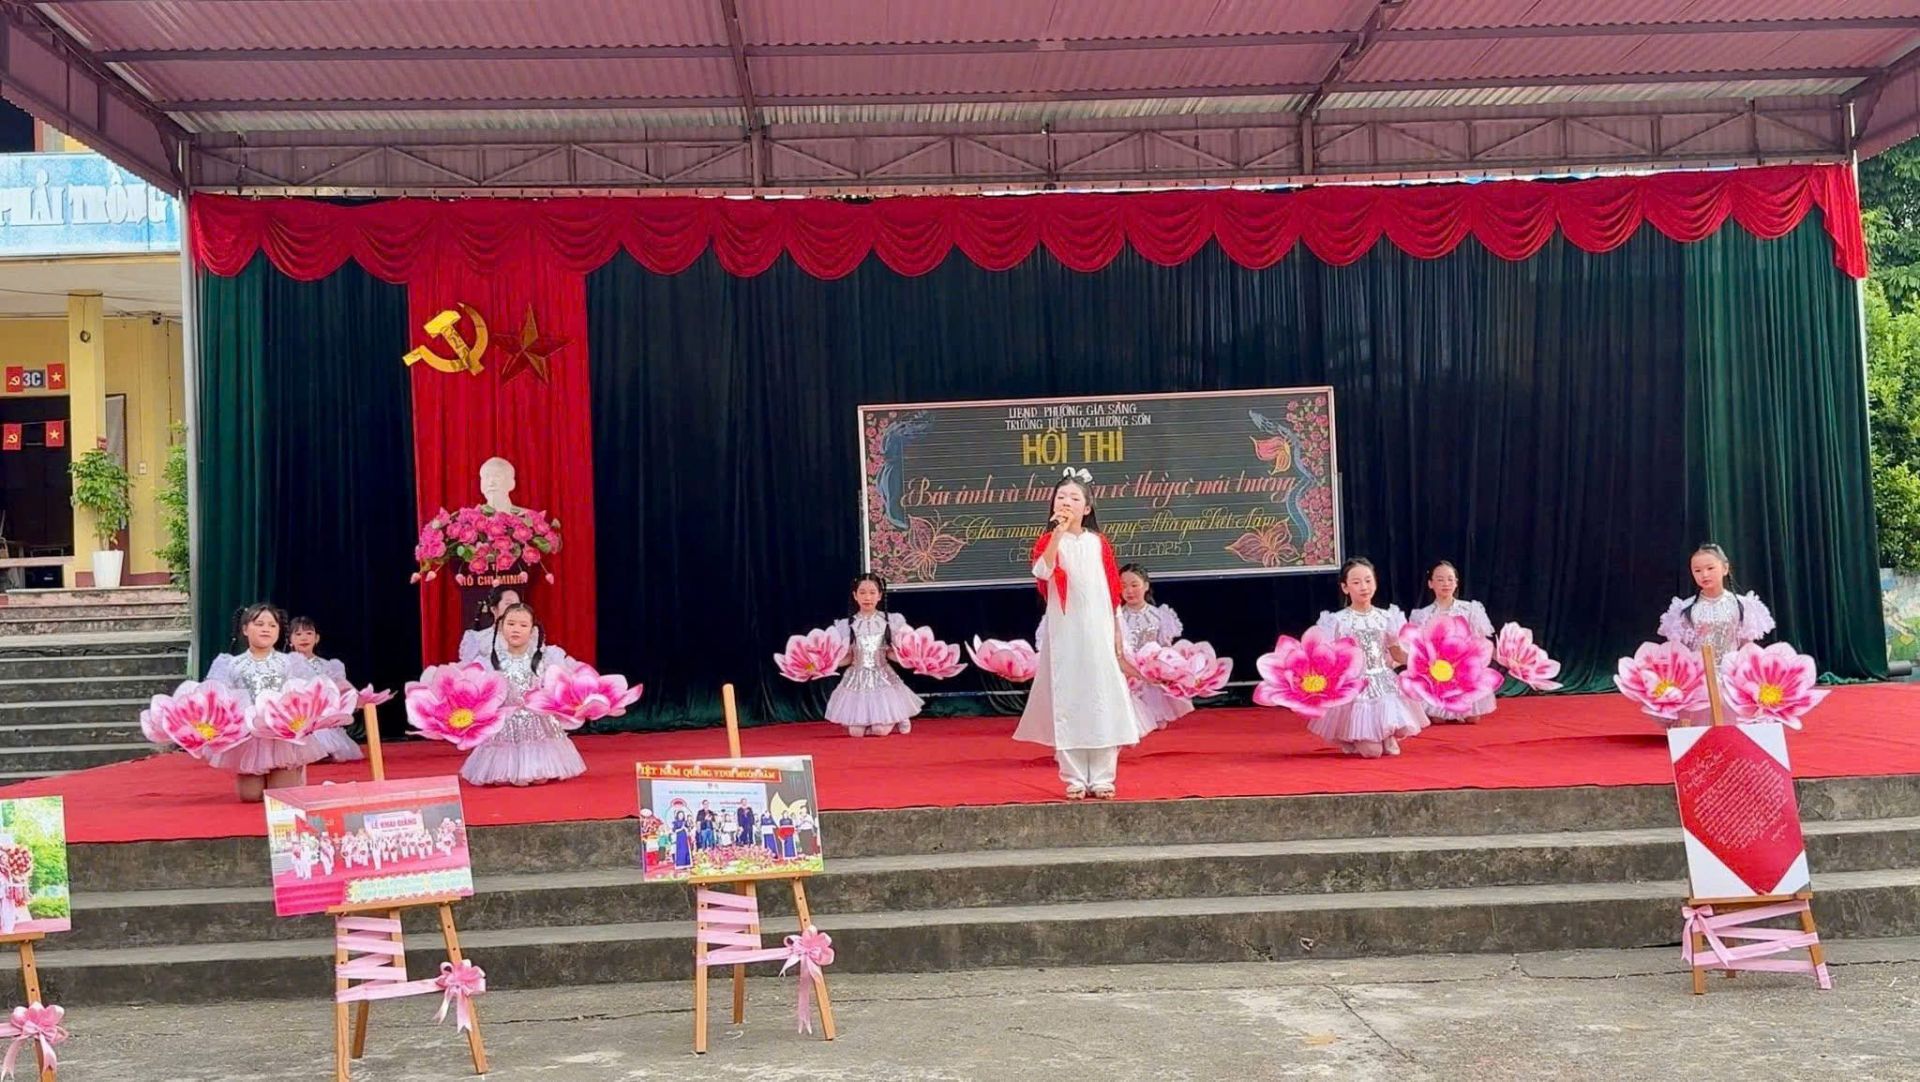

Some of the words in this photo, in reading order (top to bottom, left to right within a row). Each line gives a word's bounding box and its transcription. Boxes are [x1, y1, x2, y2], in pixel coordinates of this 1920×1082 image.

[23, 372, 41, 386] 3C
[1008, 407, 1038, 419] UBND
[1022, 428, 1068, 470] HỘI
[1078, 430, 1124, 464] THI
